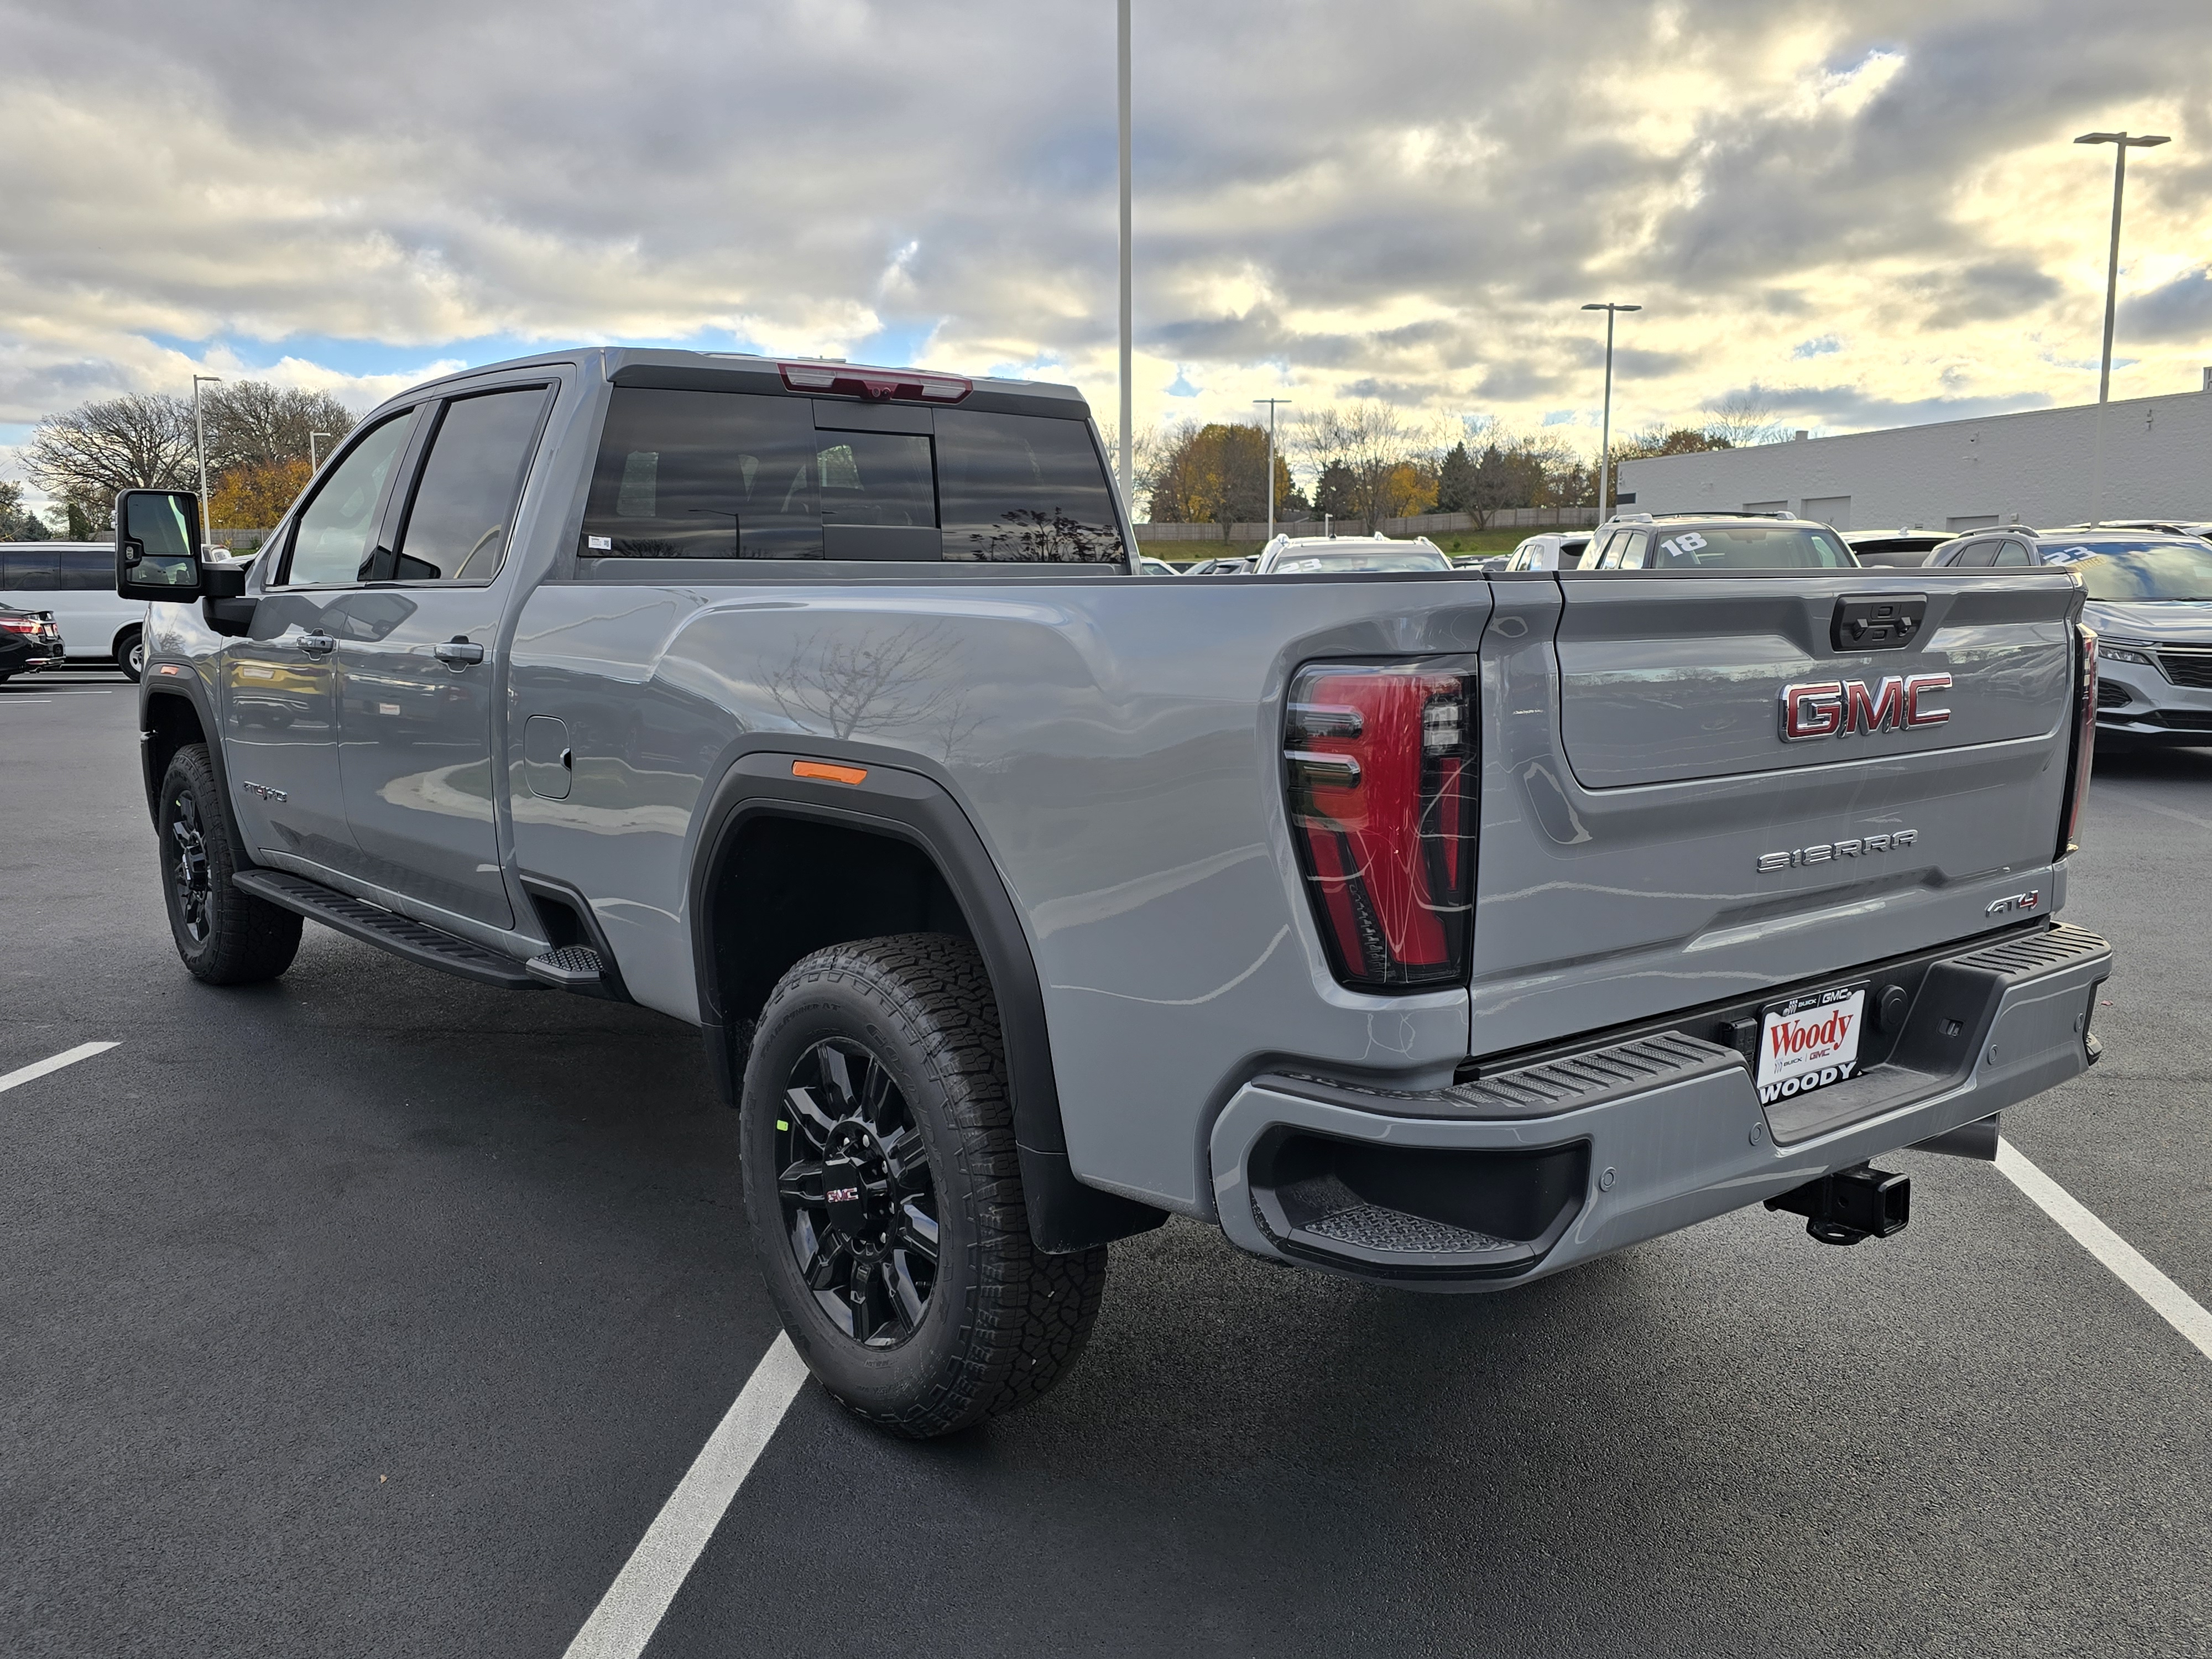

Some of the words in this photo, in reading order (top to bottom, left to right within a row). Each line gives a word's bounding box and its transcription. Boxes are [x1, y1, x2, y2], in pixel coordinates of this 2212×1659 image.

[1661, 532, 1707, 557] 18
[2043, 546, 2097, 566] 23
[1277, 558, 1322, 573] 23
[1778, 672, 1953, 743] GMC
[1756, 829, 1919, 873] SIERRA
[1985, 889, 2039, 917] AT4
[1798, 999, 1817, 1008] BUICK
[1822, 988, 1849, 1004] GMC
[1770, 1009, 1854, 1059] Woody
[1783, 1057, 1803, 1067] BUICK
[1809, 1048, 1830, 1060] GMC
[1759, 1061, 1857, 1104] WOODY
[827, 1187, 859, 1203] GMC
